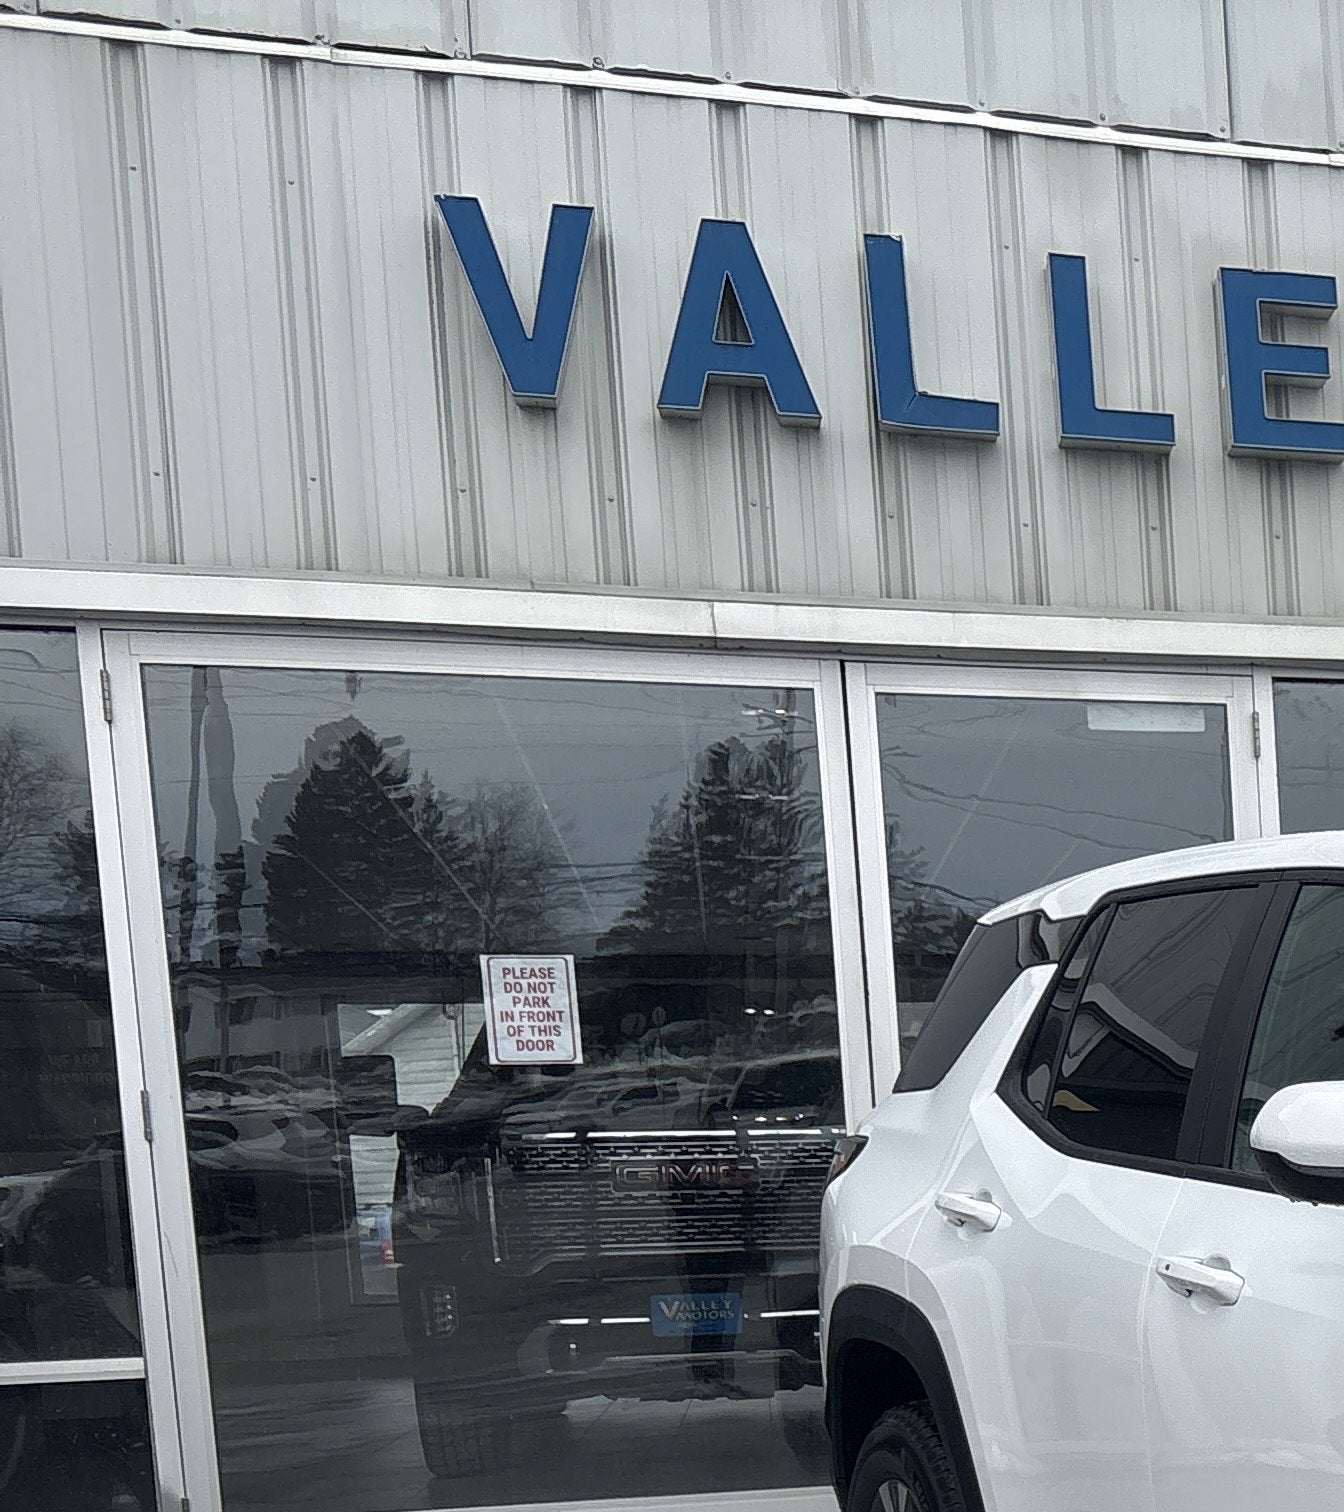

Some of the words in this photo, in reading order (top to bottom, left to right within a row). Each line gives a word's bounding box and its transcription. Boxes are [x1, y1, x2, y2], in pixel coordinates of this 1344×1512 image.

[502, 967, 556, 980] PLEASE
[503, 981, 523, 994] DO
[527, 981, 557, 994] NOT
[511, 995, 552, 1009] PARK
[499, 1010, 515, 1023] IN
[519, 1010, 565, 1023] FRONT
[506, 1025, 525, 1037] OF
[528, 1025, 562, 1037] THIS
[516, 1039, 555, 1052] DOOR
[659, 1299, 733, 1319] VALLEY
